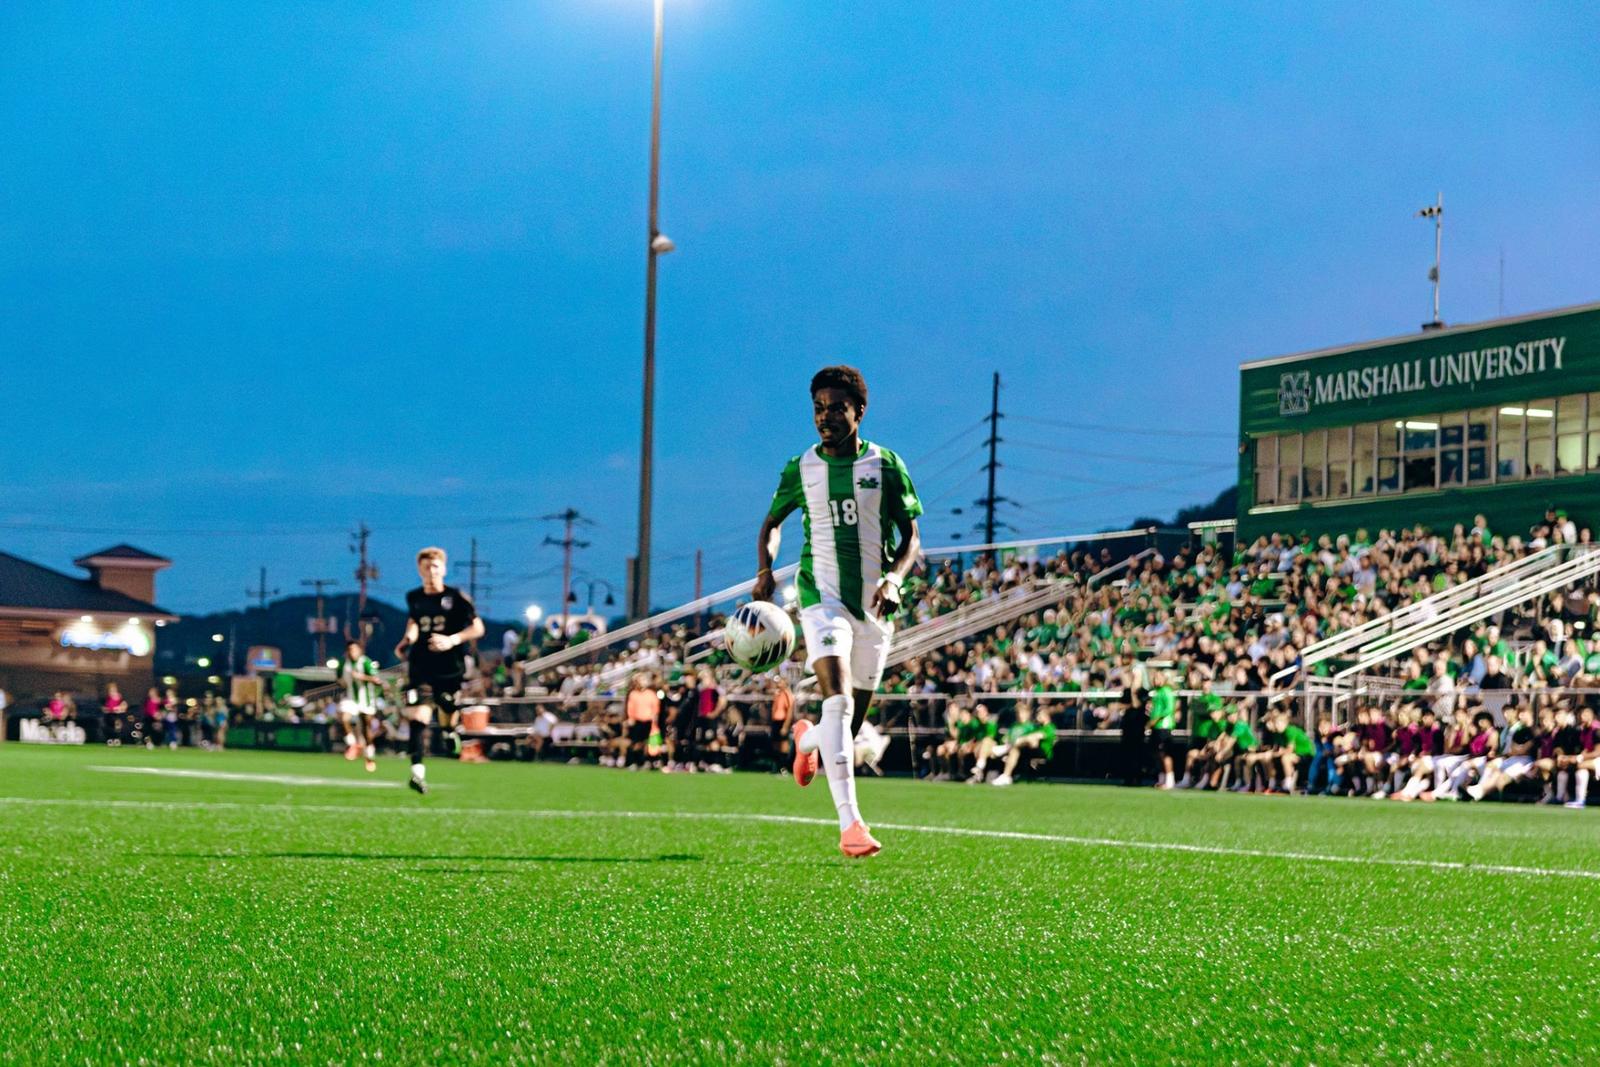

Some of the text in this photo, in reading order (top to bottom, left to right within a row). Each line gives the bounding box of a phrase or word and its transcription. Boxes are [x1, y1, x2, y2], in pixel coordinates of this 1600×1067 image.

[1313, 336, 1567, 405] MARSHALL UNIVERSITY
[828, 498, 858, 527] 18
